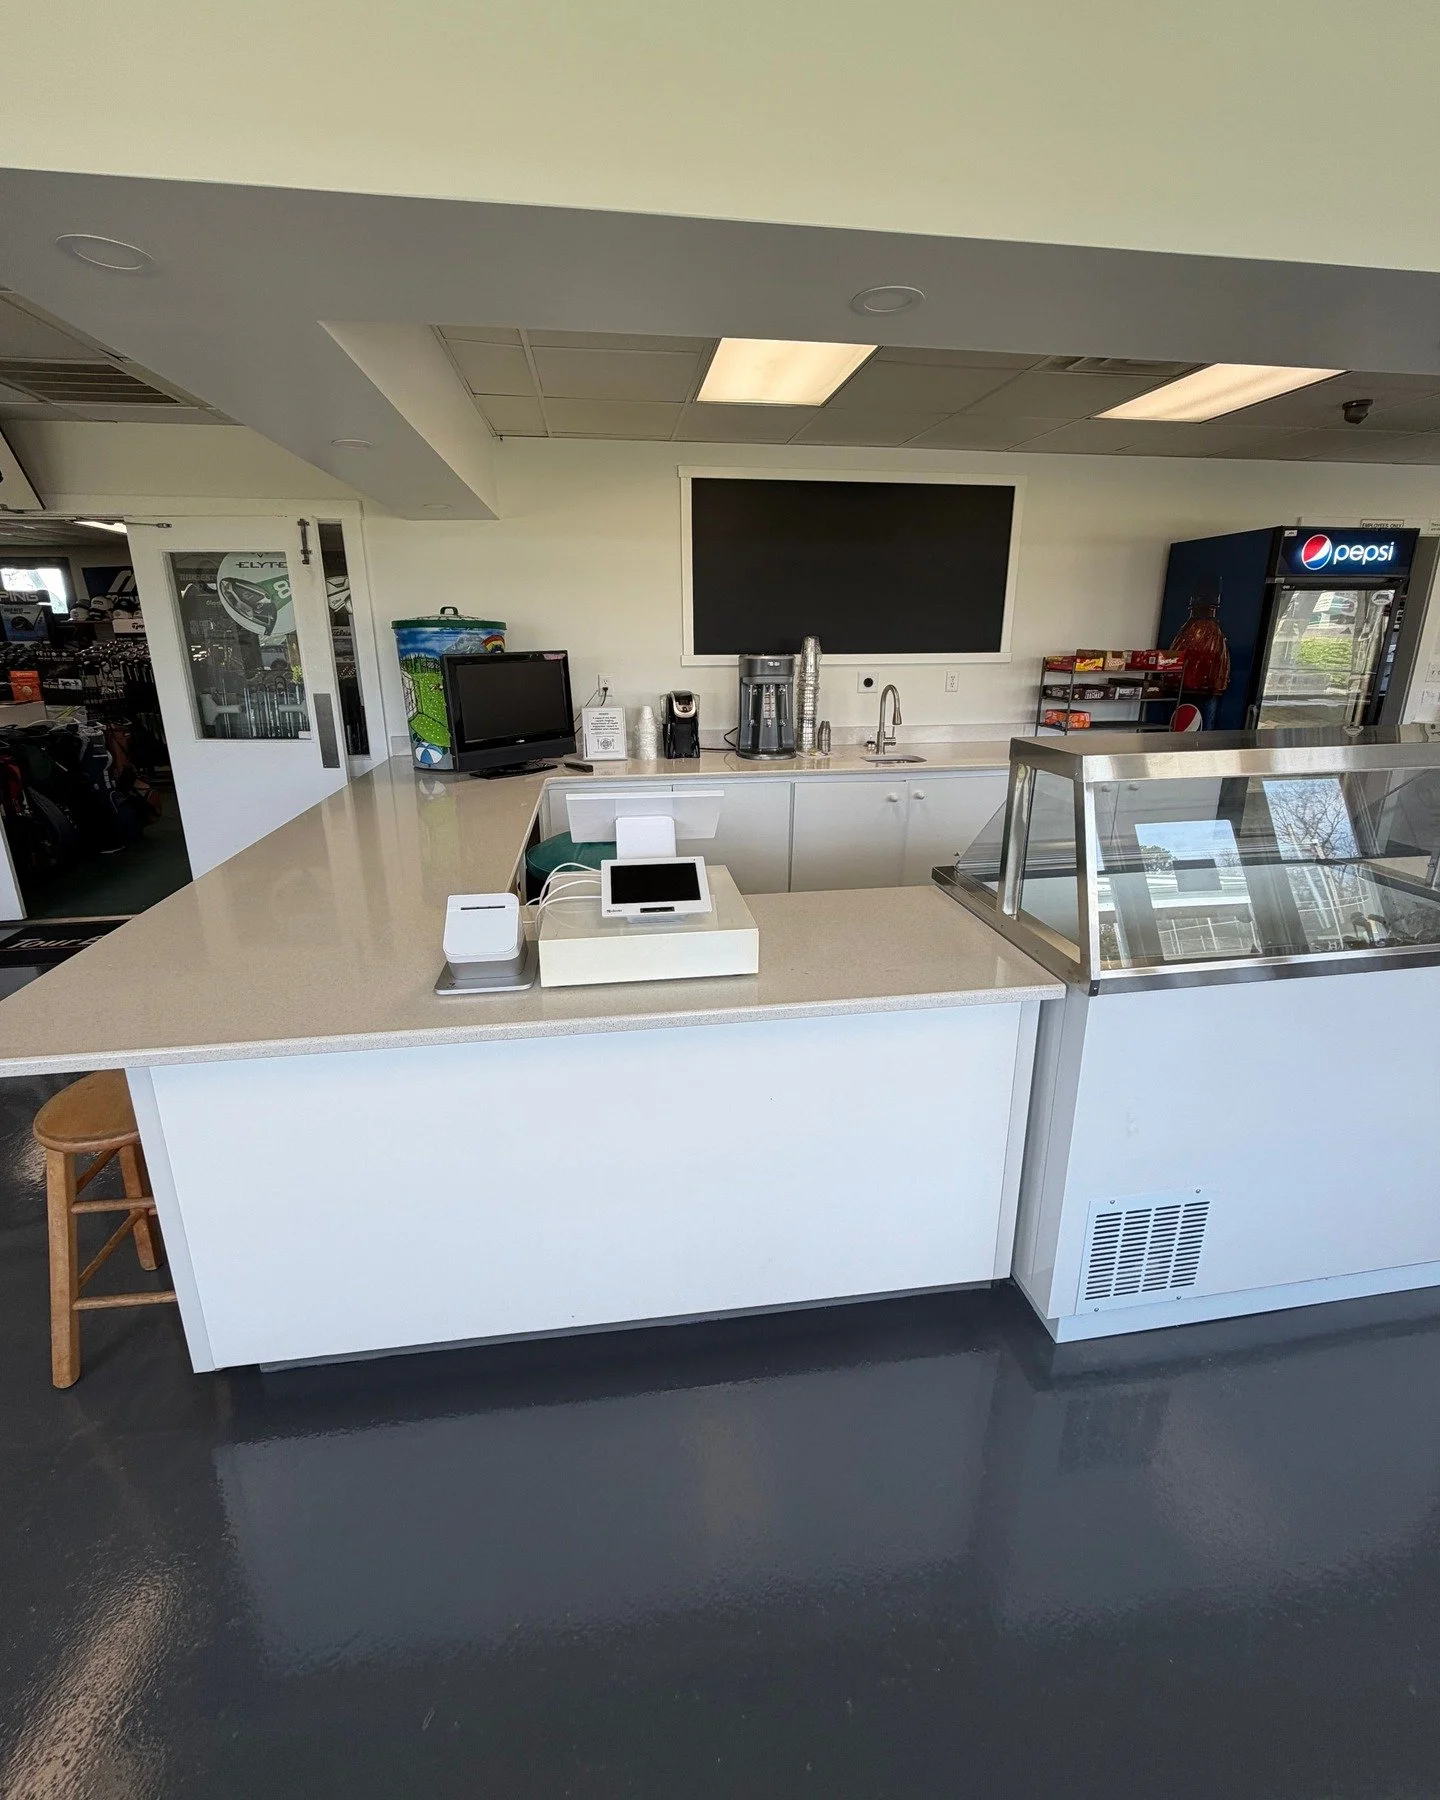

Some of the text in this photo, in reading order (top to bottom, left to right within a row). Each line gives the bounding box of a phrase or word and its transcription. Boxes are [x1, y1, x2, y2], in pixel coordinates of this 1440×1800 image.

[1333, 541, 1395, 565] pepsi
[236, 561, 287, 569] ELYTE
[5, 938, 82, 949] Tour
